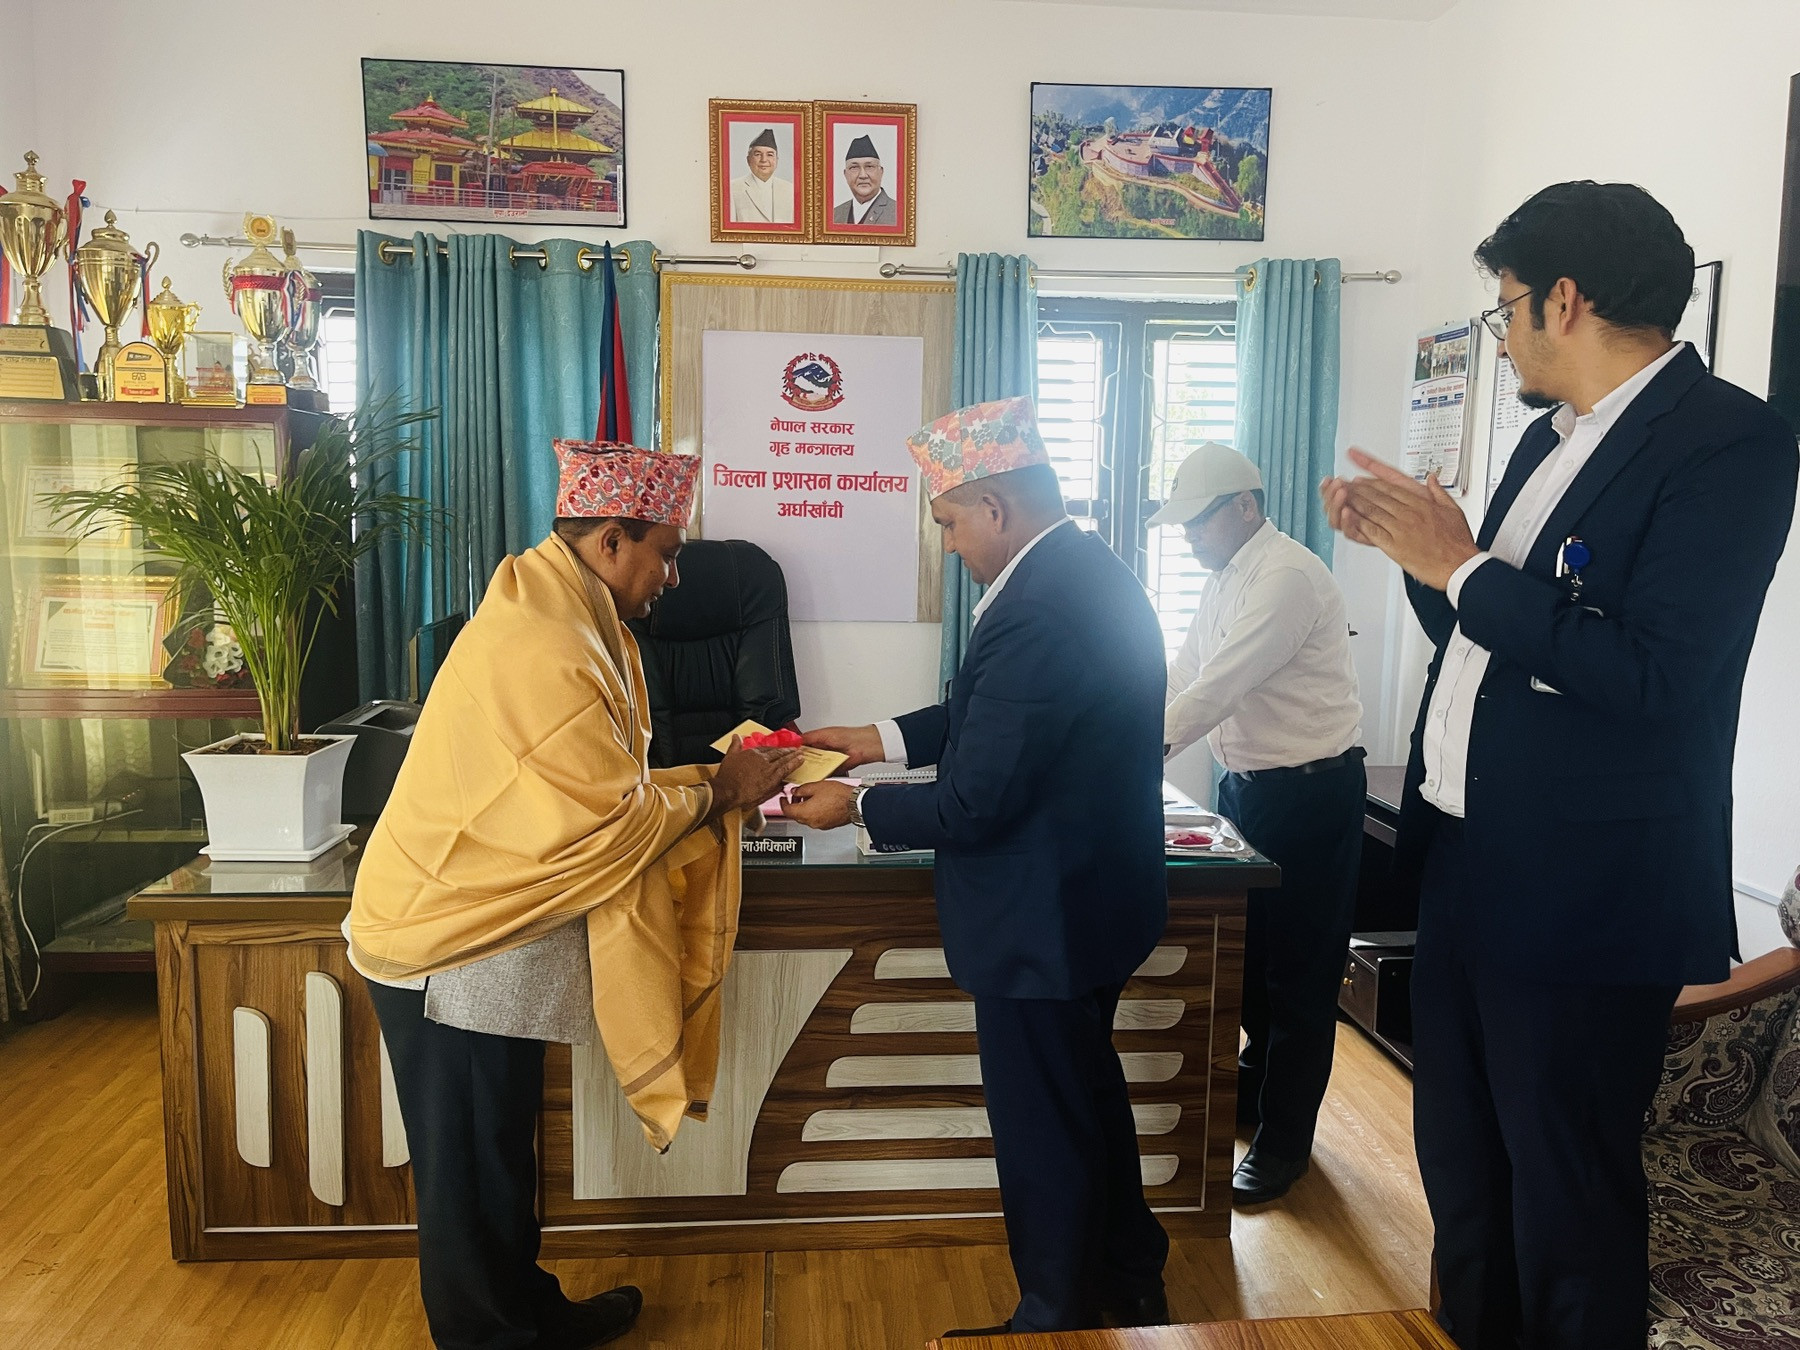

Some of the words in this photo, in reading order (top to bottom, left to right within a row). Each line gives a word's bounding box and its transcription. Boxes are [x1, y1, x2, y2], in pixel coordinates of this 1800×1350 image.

[770, 416, 806, 434] नेपाल
[810, 420, 855, 435] सरकार
[769, 440, 790, 458] गृह
[795, 441, 855, 457] मन्त्रालय
[713, 463, 767, 489] जिल्ला
[772, 470, 832, 493] प्रशासन
[837, 470, 909, 493] कार्यालय
[777, 500, 844, 519] अर्घाखाँची
[753, 838, 797, 853] अधिकारी
